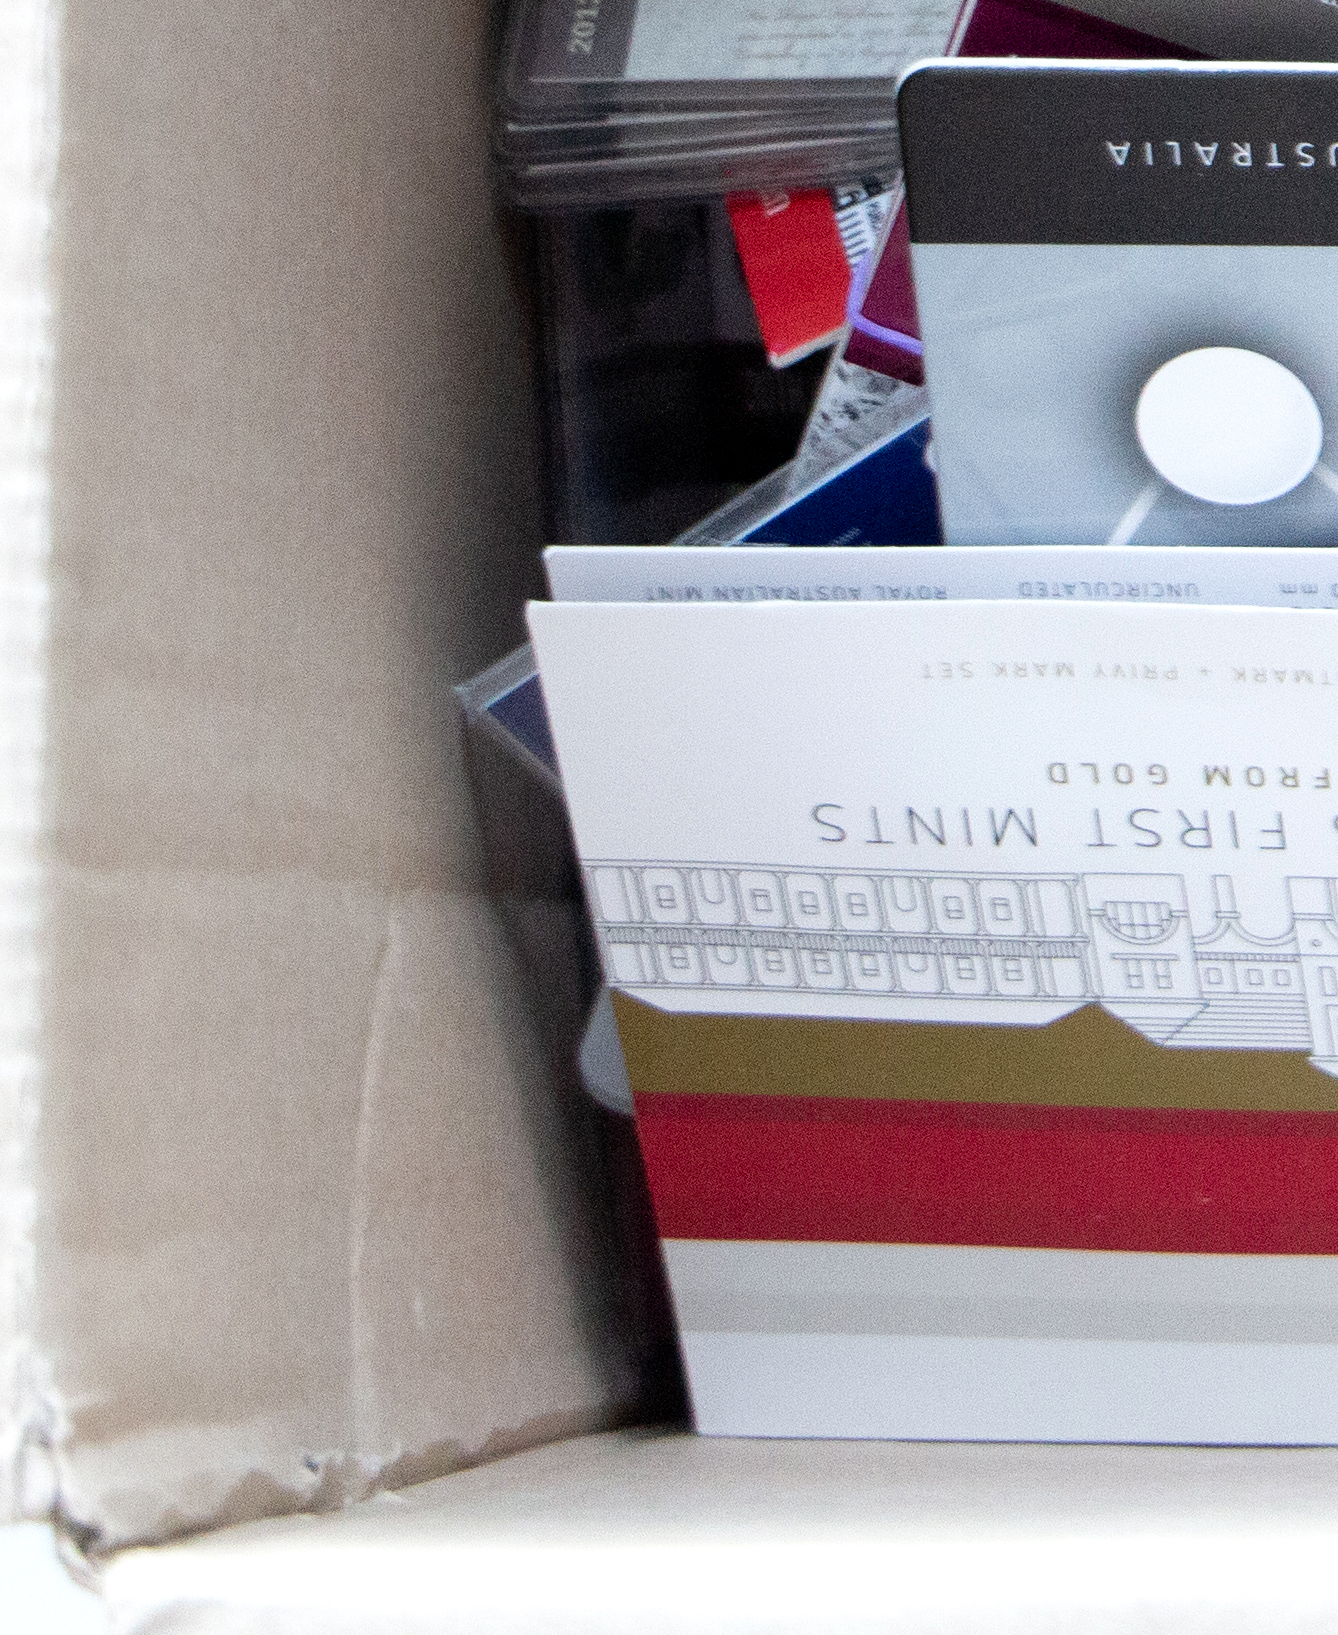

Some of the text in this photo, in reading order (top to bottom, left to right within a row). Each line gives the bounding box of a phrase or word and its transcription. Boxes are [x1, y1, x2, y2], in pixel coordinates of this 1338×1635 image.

[645, 584, 702, 602] MINT
[711, 583, 863, 602] AUSTRALIAN
[876, 584, 948, 601] ROYAL
[1017, 579, 1200, 599] UNCIRCULATED
[922, 661, 974, 679] SET
[993, 661, 1076, 679] MARK
[1092, 663, 1179, 682] PRIVY
[1047, 762, 1168, 785] GOLD
[1203, 764, 1331, 790] FROM
[811, 803, 1038, 847] MINTS
[1087, 808, 1288, 851] FIRST
